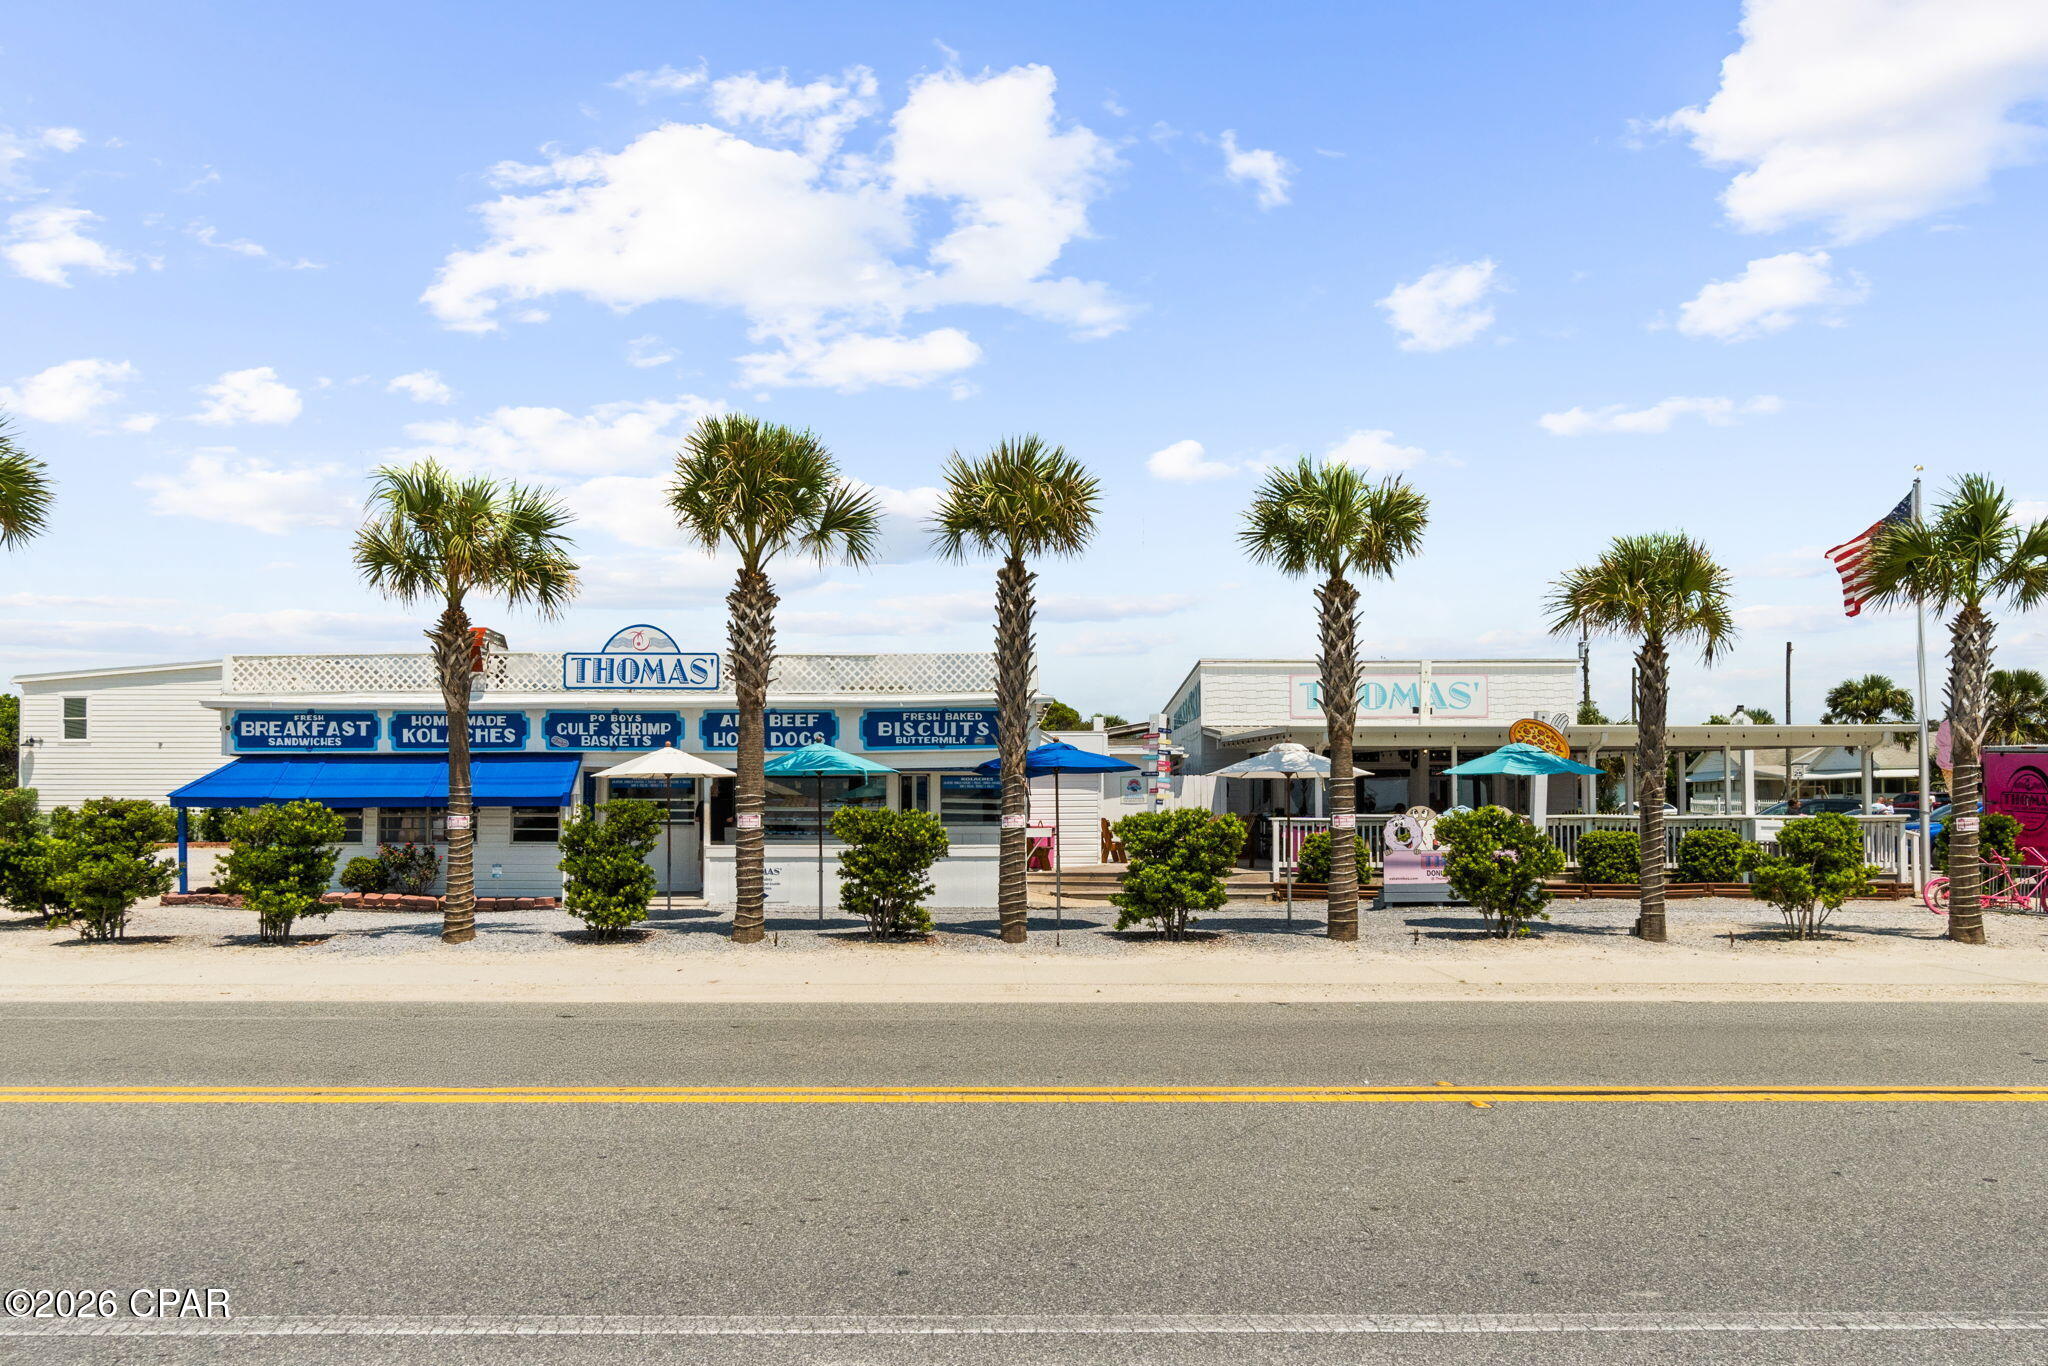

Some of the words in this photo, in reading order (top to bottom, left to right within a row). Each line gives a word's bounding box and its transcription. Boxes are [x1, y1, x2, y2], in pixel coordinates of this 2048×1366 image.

[571, 657, 715, 684] THOMAS'
[1299, 681, 1479, 710] TOMAS'
[411, 715, 449, 727] HOM
[590, 714, 605, 722] PO
[610, 714, 642, 722] BOYS
[769, 714, 820, 727] BEEF
[903, 712, 941, 721] FRESH
[945, 712, 983, 721] BAKED
[240, 721, 371, 737] BREAKFAST
[556, 722, 600, 735] GULF
[610, 722, 672, 735] SHRIMP
[877, 721, 990, 737] BISCUITS
[268, 737, 342, 746] SANDWICHES
[581, 735, 652, 747] BASKETS
[713, 731, 739, 747] HO
[770, 731, 826, 746] DOGS
[895, 736, 967, 745] BUTTERMILK
